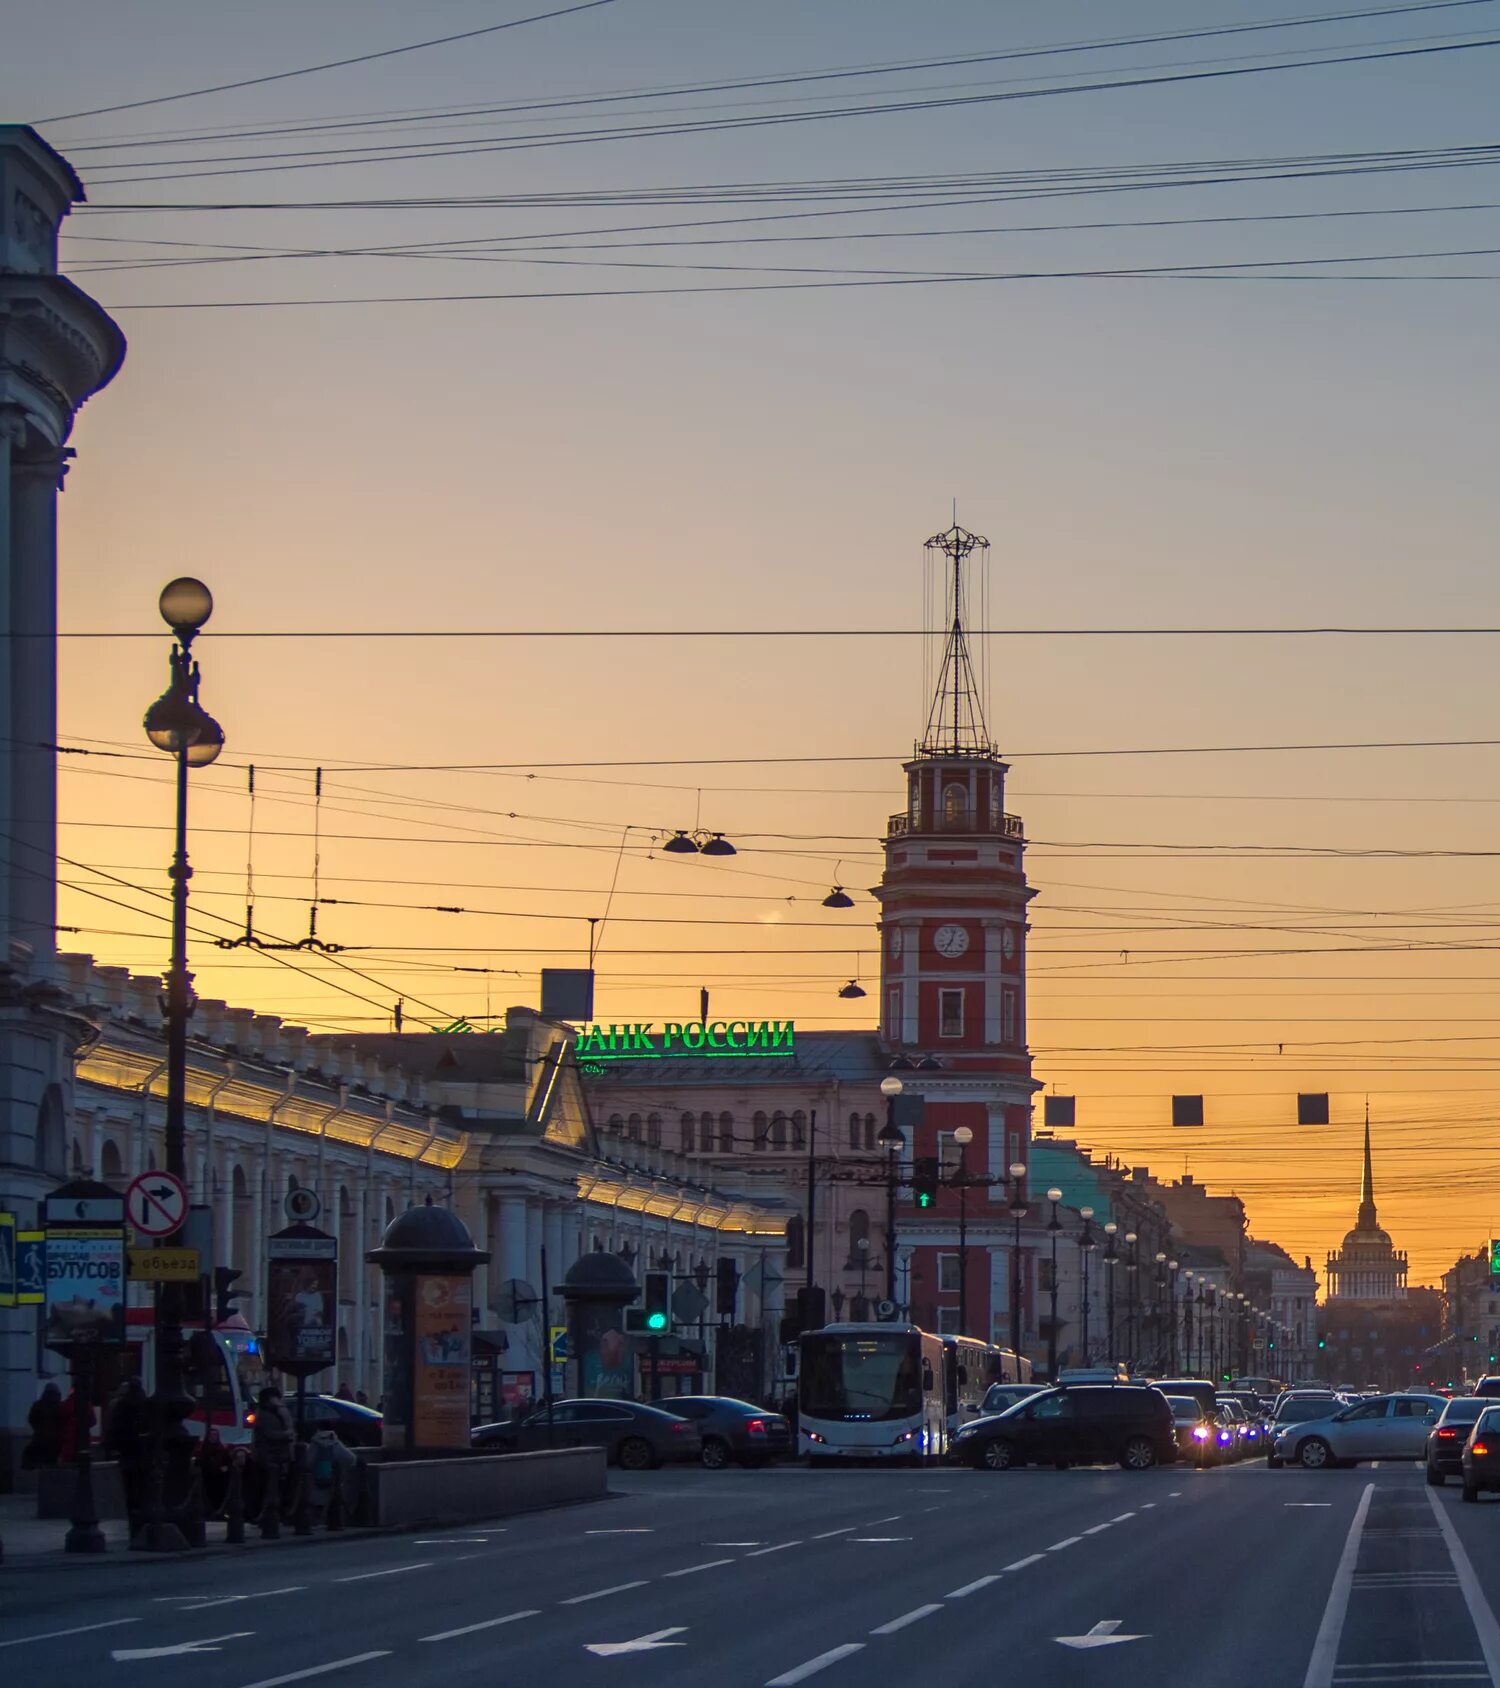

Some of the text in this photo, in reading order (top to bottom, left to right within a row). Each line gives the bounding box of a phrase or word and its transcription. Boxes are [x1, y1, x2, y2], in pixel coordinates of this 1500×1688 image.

[663, 1020, 794, 1050] РОССИИ
[47, 1261, 120, 1279] БУТУСОВ
[142, 1256, 196, 1270] объезд
